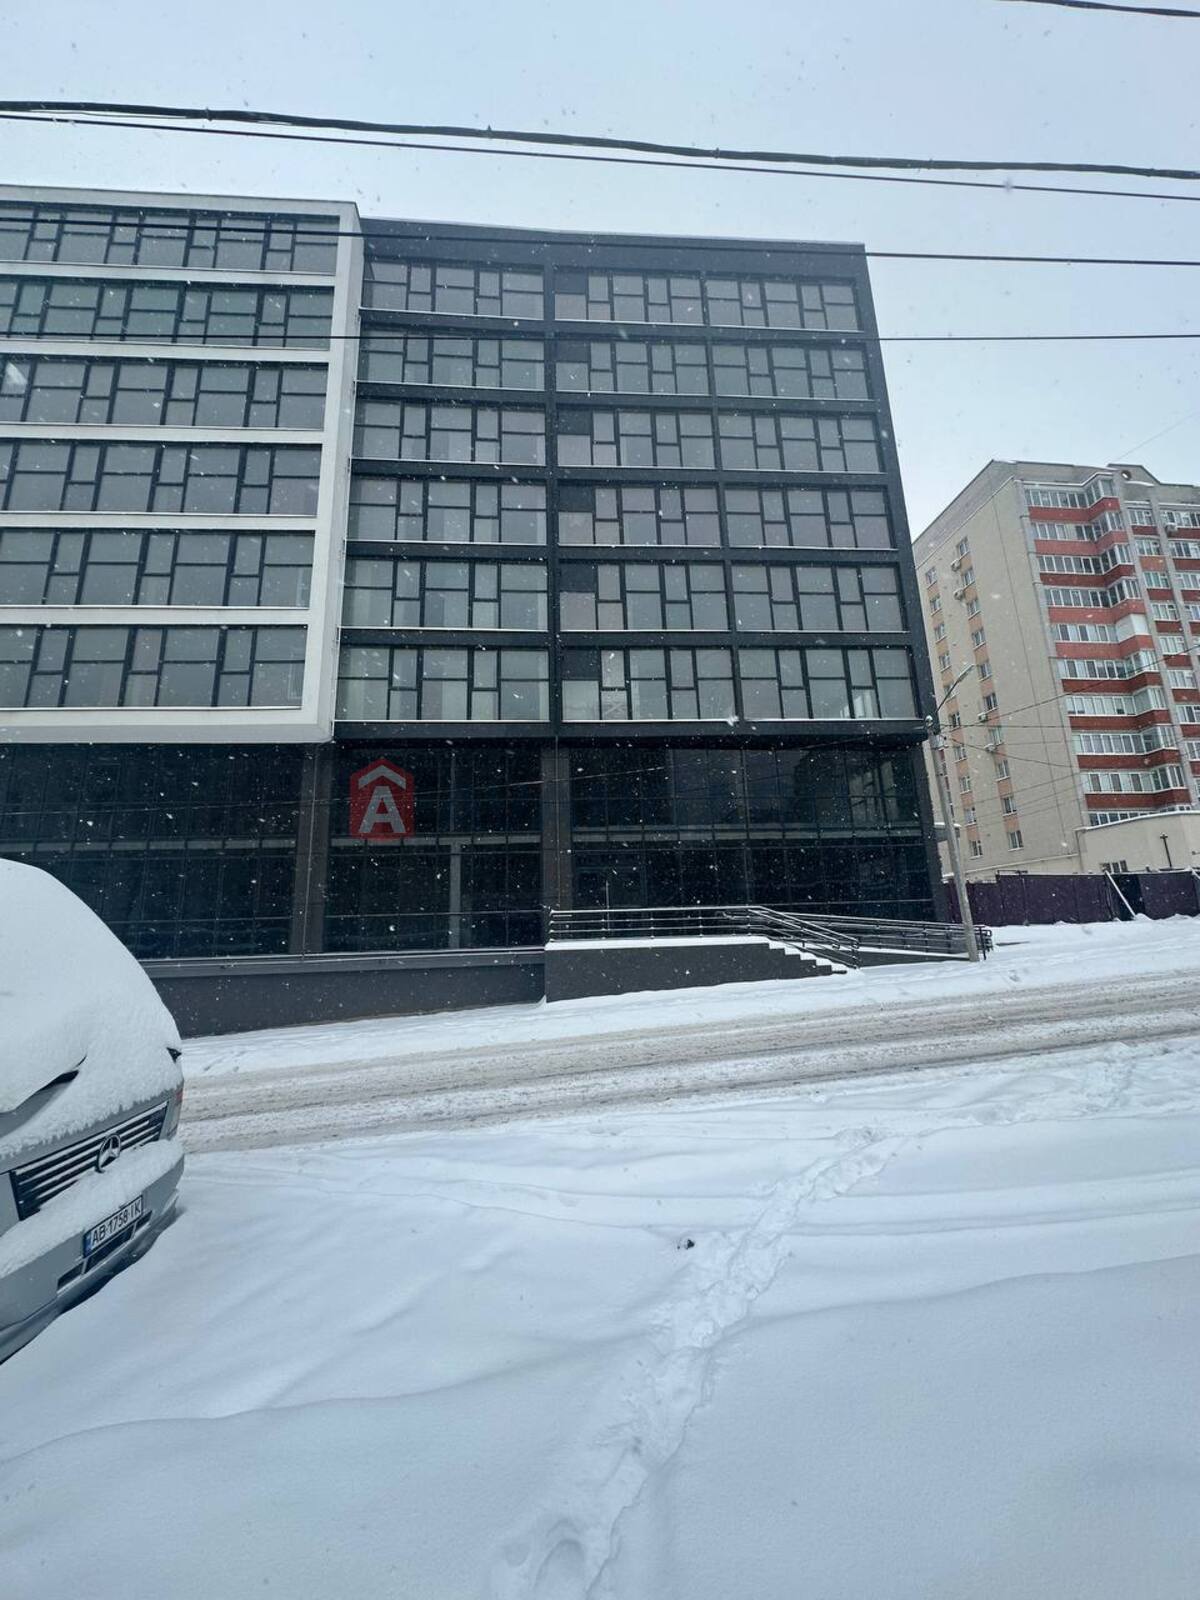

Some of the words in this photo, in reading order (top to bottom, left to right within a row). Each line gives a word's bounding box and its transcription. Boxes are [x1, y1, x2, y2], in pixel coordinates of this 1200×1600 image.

[92, 1224, 106, 1246] AB
[108, 1208, 128, 1233] 1758
[130, 1199, 141, 1218] IK
